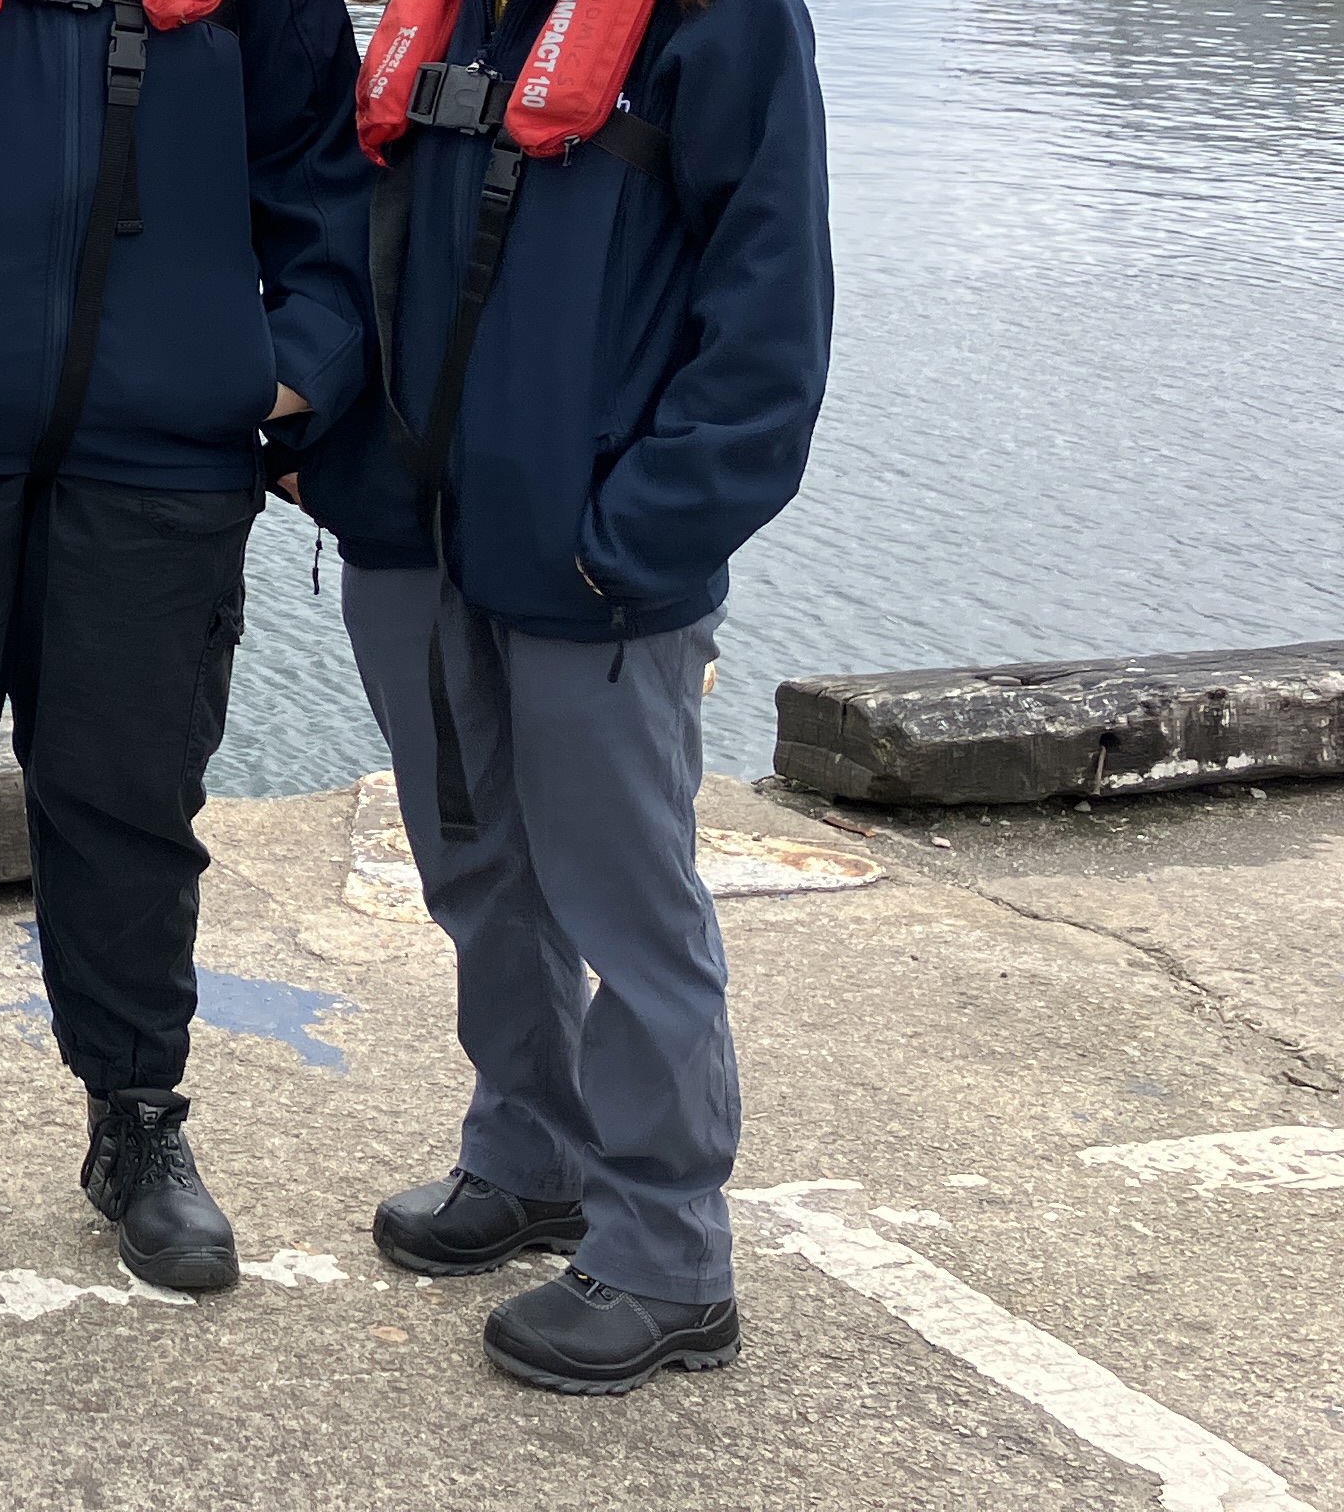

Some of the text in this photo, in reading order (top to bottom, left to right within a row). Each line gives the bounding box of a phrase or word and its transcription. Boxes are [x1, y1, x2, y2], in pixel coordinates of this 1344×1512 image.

[370, 39, 411, 99] ISO 12402
[521, 76, 550, 108] 150
